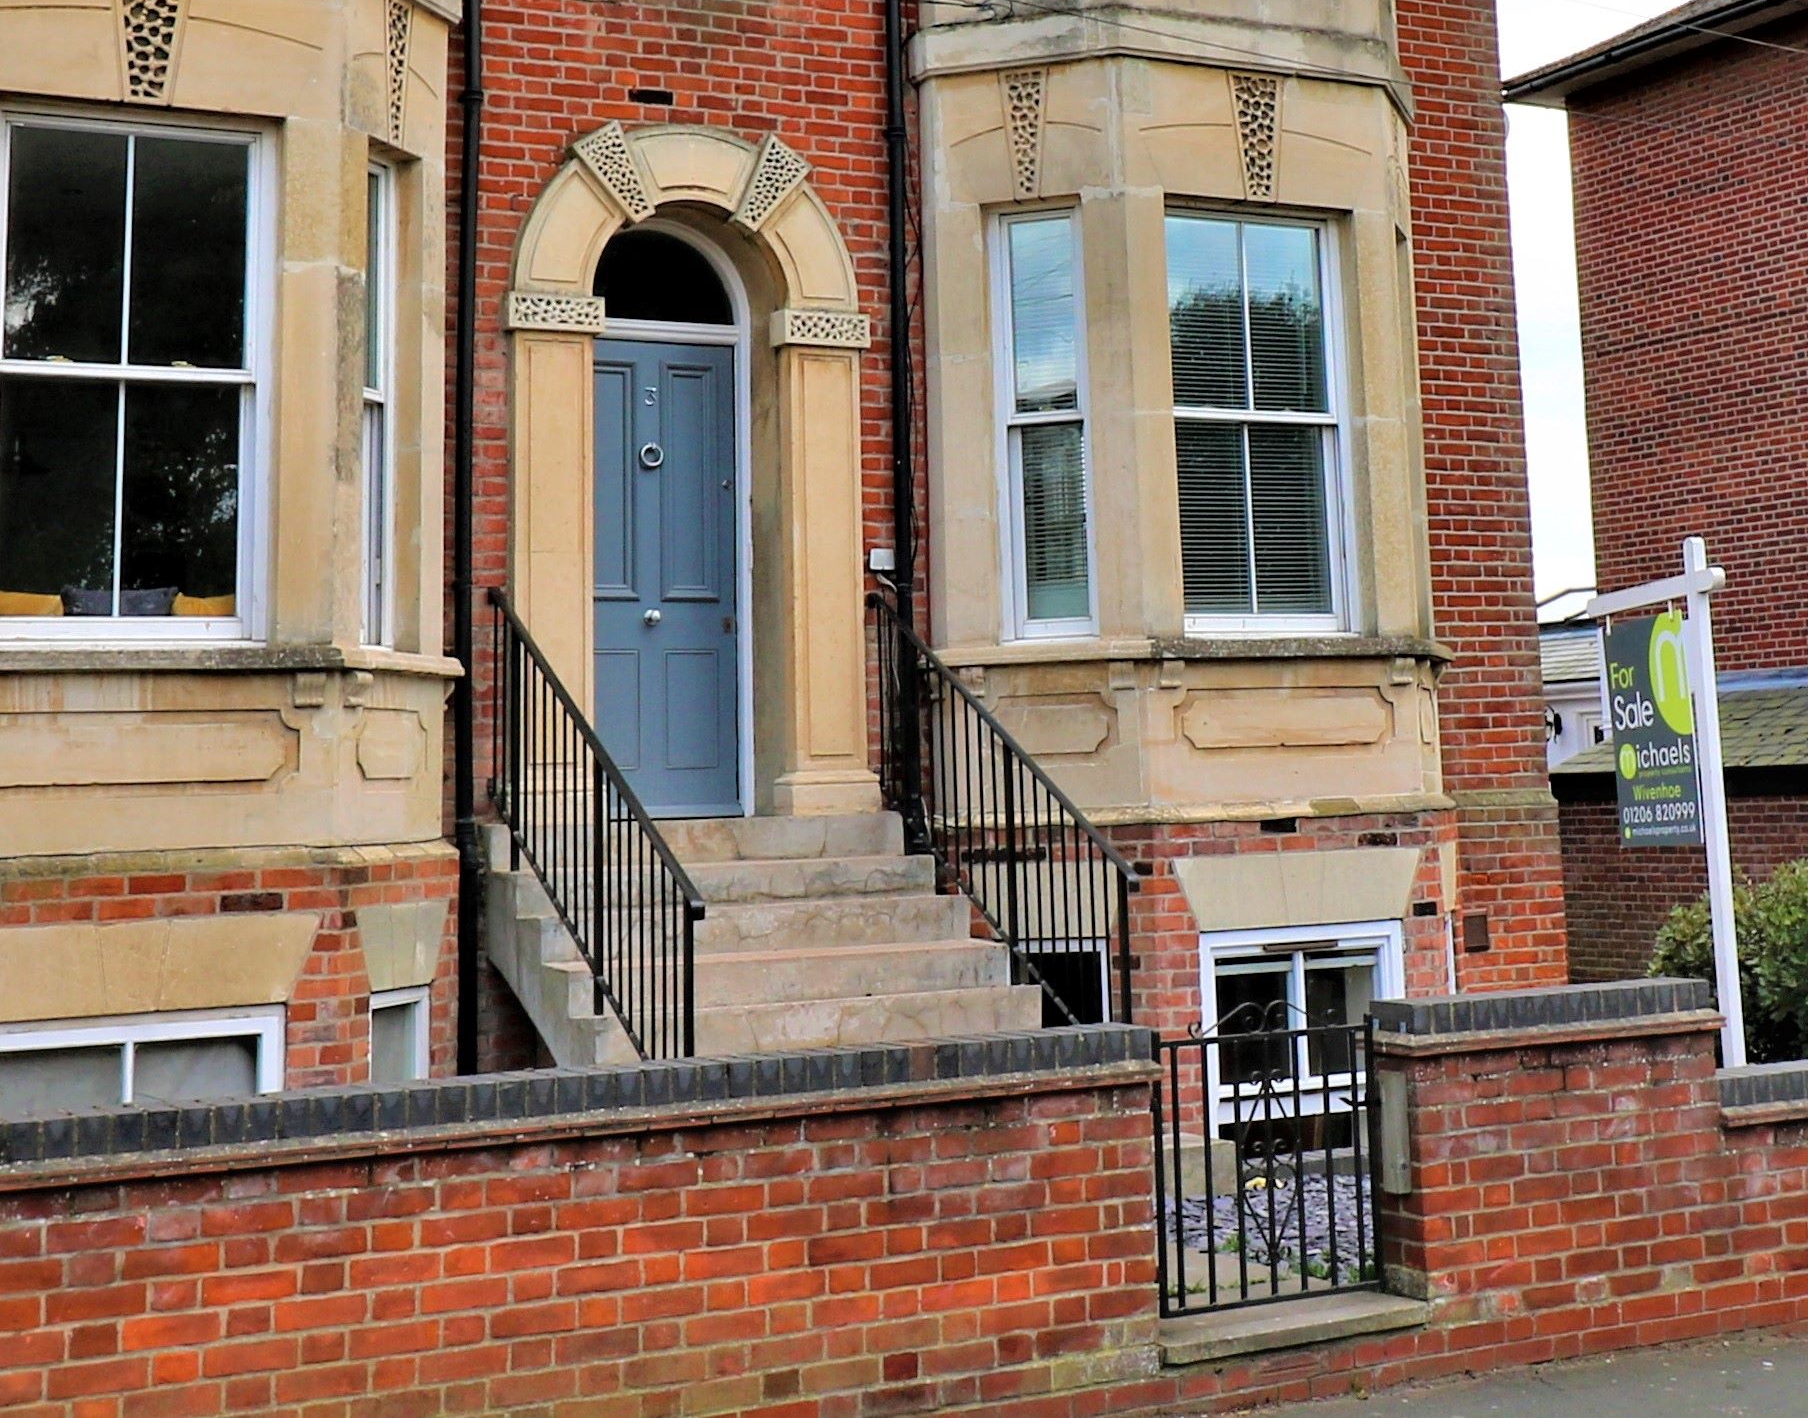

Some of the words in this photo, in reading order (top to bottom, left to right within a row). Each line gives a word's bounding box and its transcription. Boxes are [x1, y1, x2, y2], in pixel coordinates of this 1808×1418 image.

[644, 387, 657, 406] 3
[1610, 663, 1634, 690] For
[1614, 691, 1654, 731] Sale
[1633, 782, 1681, 801] Wivenhoe
[1623, 805, 1653, 824] 01206
[1655, 801, 1696, 821] 820999
